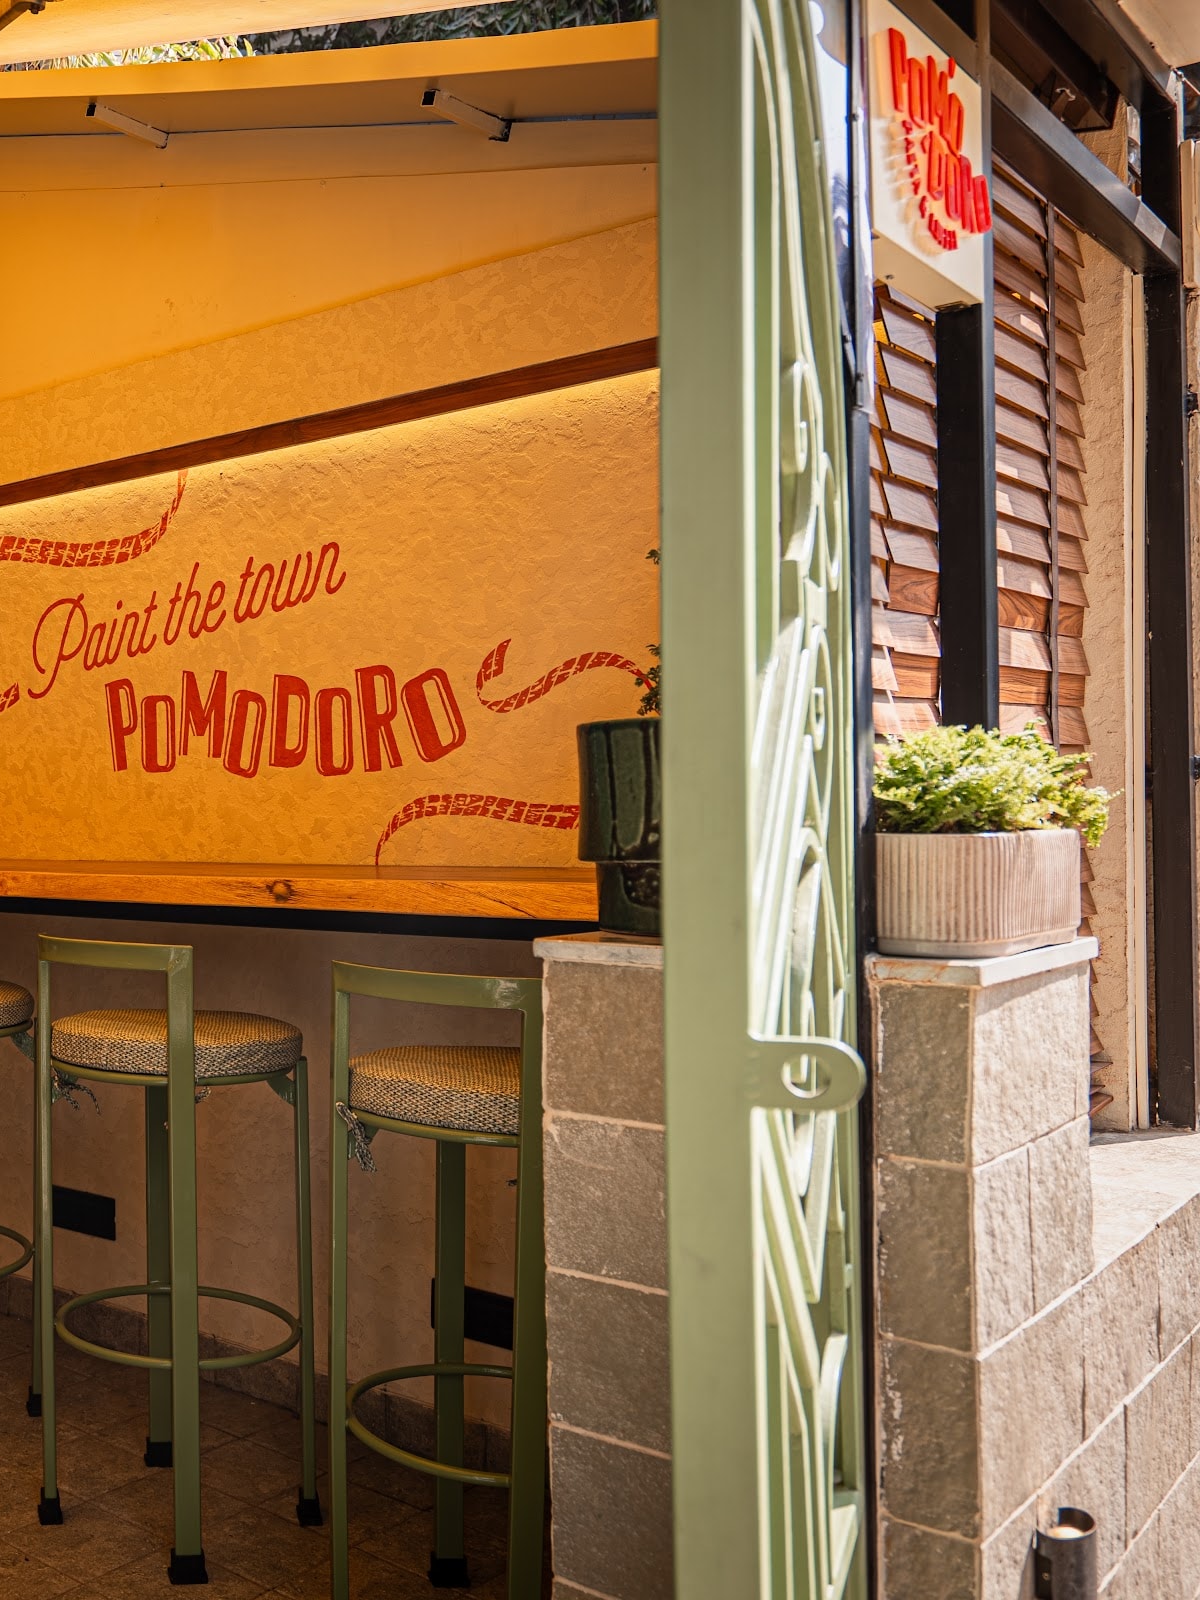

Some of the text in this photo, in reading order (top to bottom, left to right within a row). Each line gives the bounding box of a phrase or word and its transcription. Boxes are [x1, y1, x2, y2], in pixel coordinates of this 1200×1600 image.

[28, 541, 347, 699] Paint the town
[104, 664, 467, 779] POMODORO
